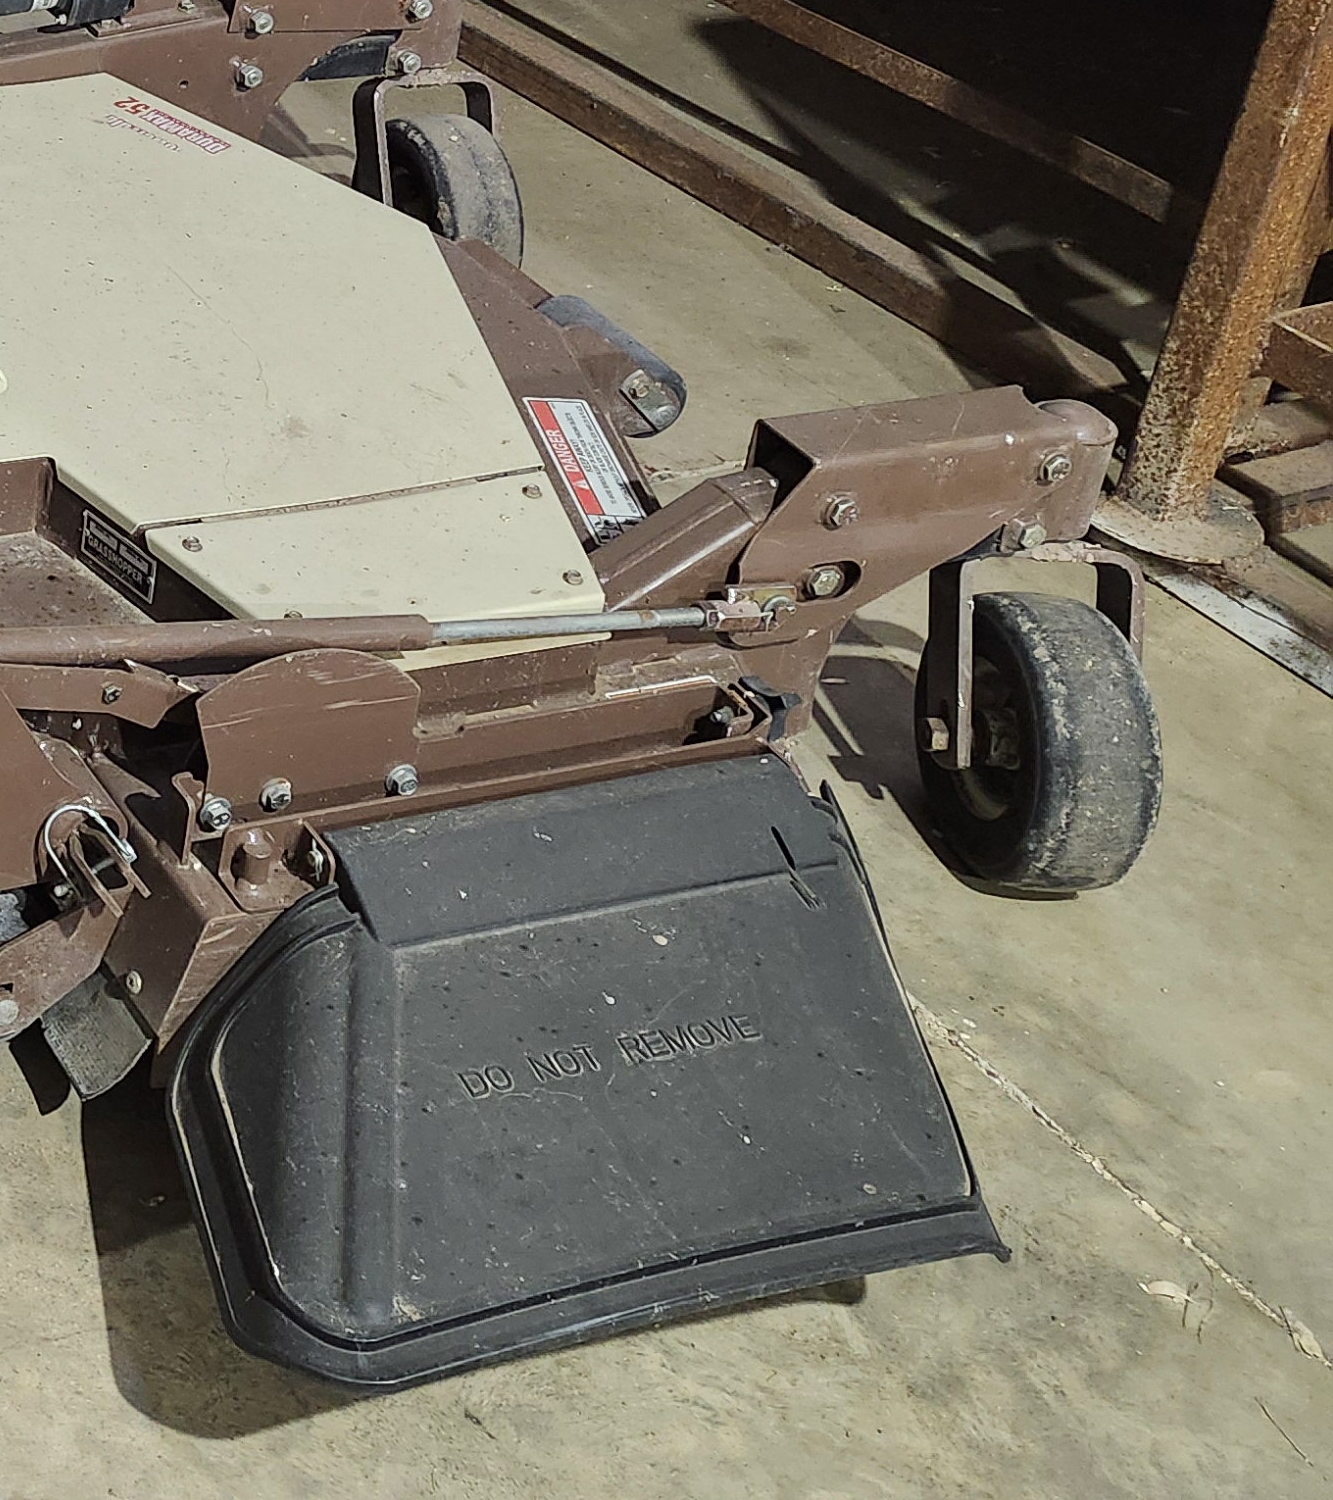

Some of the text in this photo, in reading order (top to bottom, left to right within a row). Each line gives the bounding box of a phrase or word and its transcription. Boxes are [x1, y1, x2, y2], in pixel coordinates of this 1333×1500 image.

[112, 95, 151, 116] 52
[544, 429, 582, 473] DANGER
[454, 1014, 763, 1099] DO NOT REMOVE
